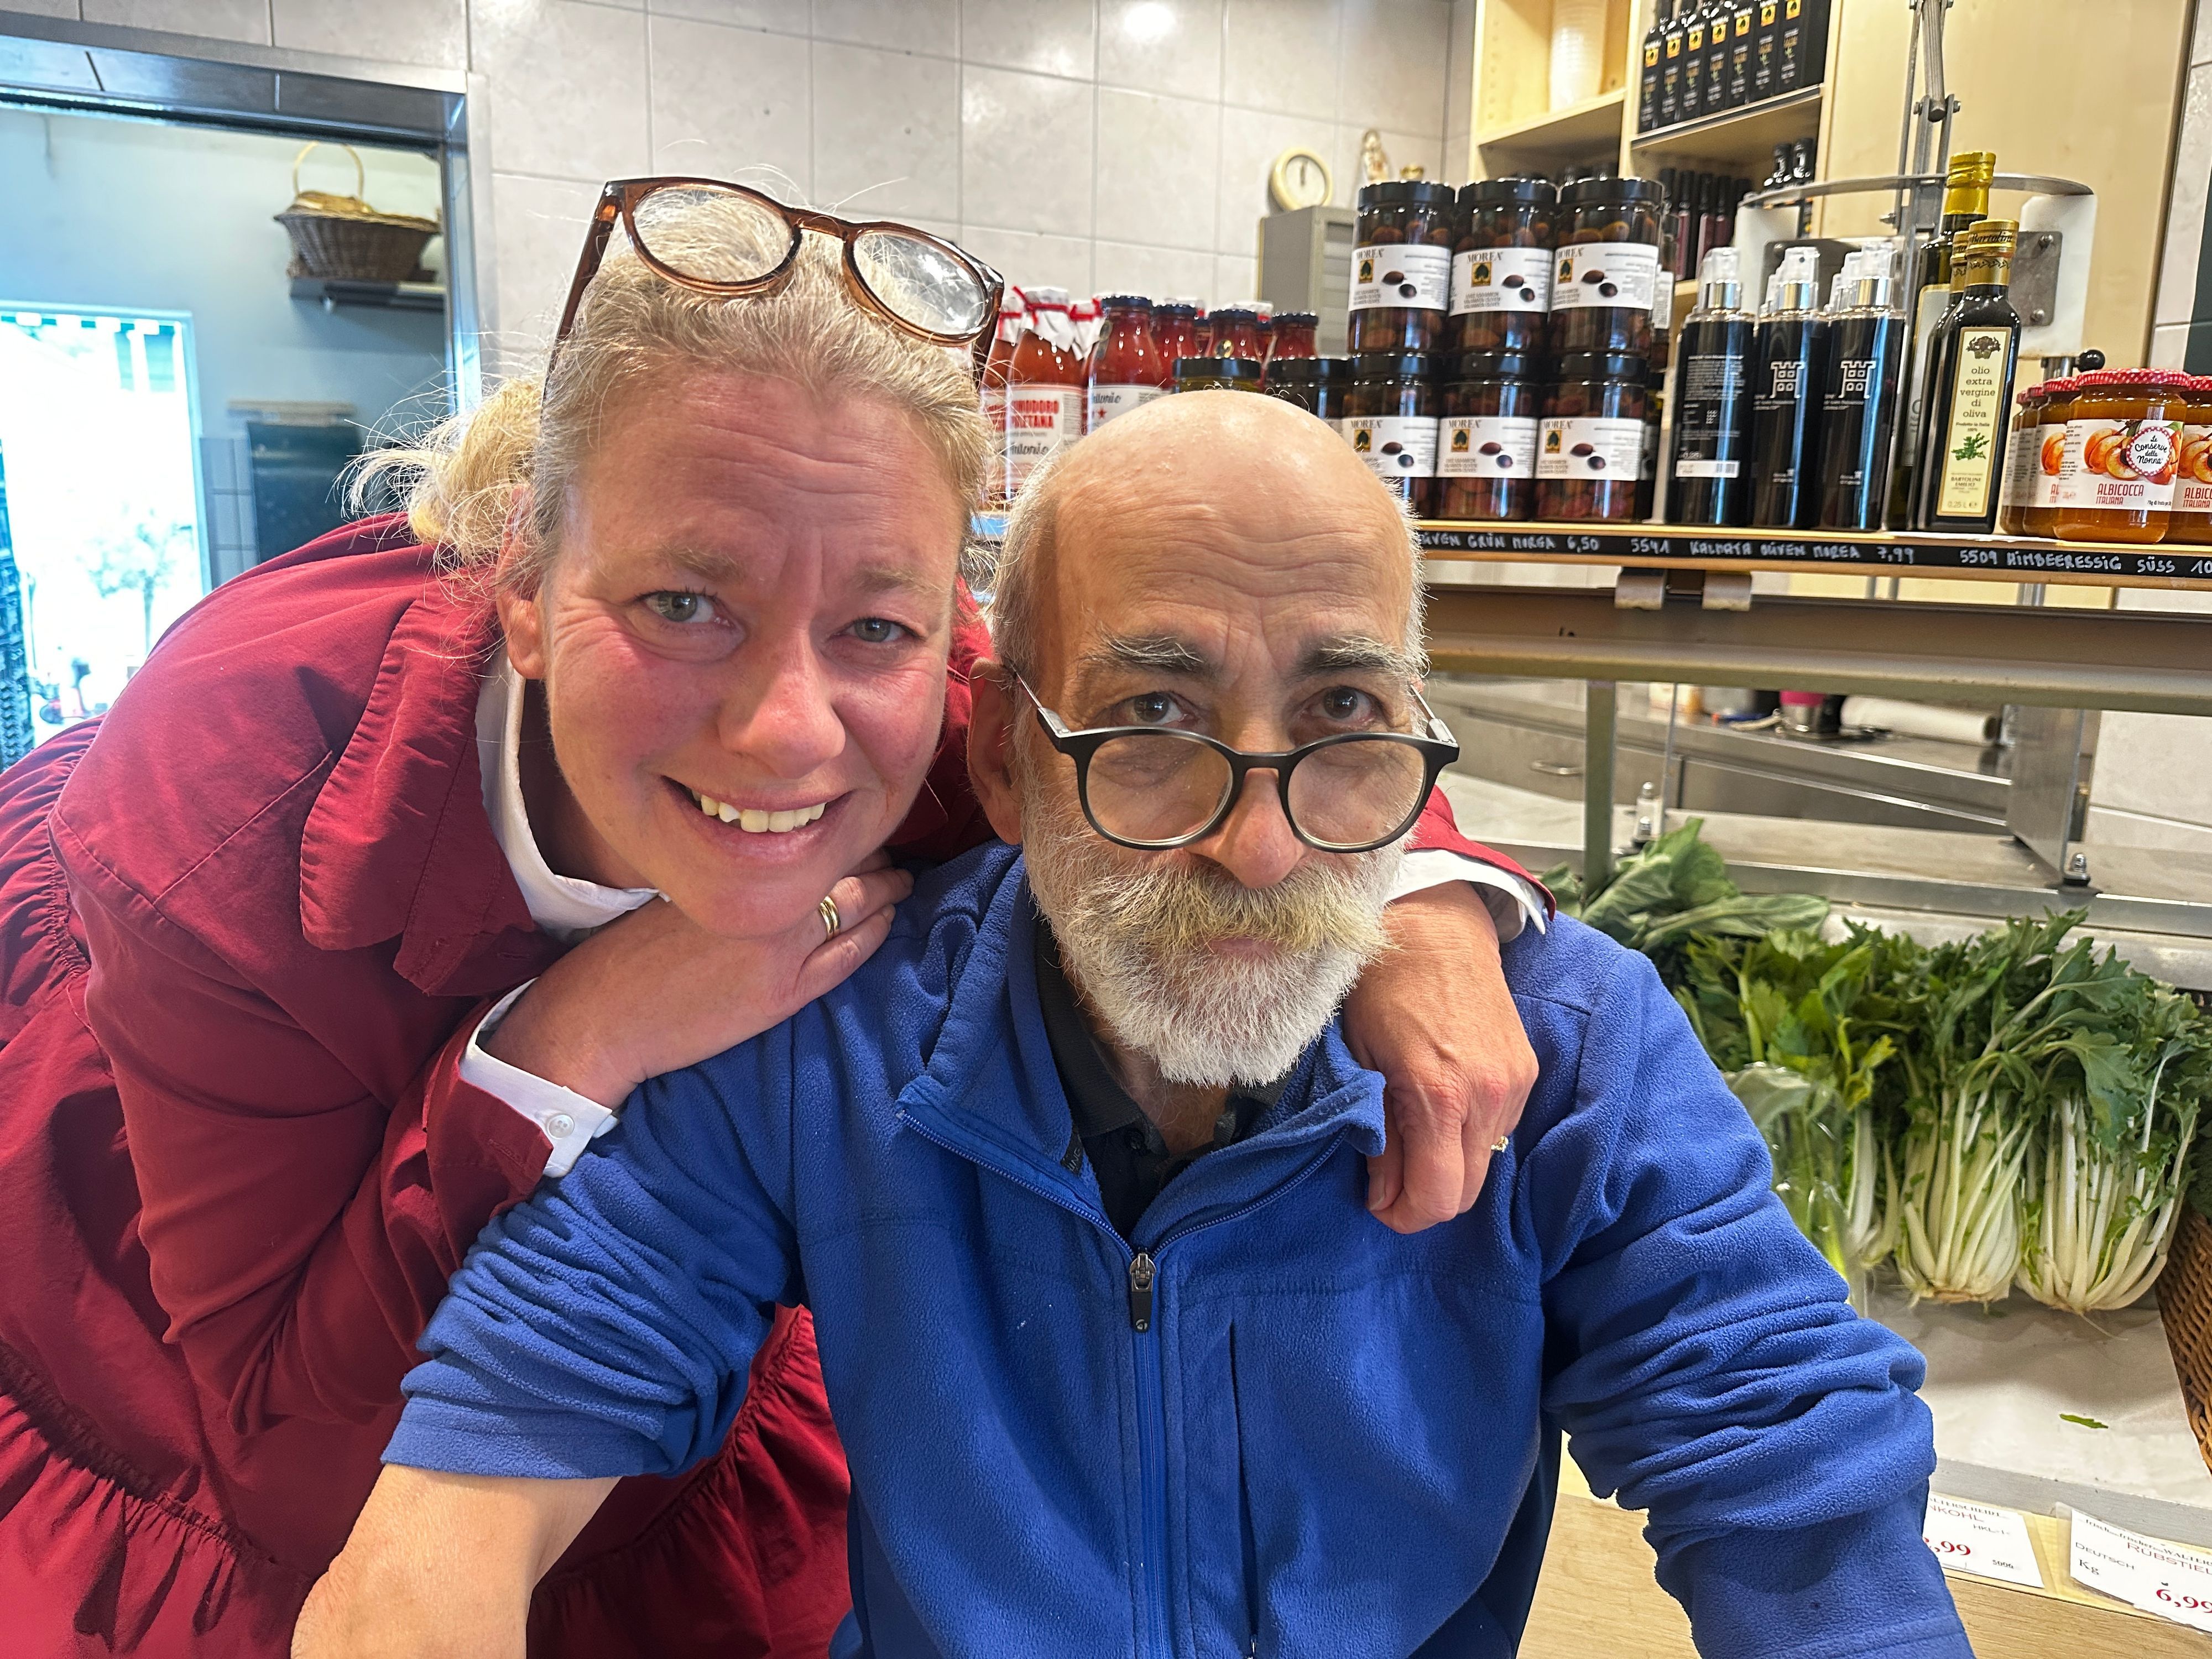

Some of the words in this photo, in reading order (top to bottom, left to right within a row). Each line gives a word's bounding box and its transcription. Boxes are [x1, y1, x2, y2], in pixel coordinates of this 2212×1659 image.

[1971, 366, 1990, 374] olio
[1960, 388, 1995, 398] vergine
[1963, 409, 1986, 418] oliva
[2135, 443, 2167, 453] Conserve
[2137, 455, 2162, 464] Nonna
[2097, 483, 2144, 496] ALBICOCCA
[2096, 497, 2124, 505] ITALIANA
[2183, 499, 2210, 508] ITALIANA
[1959, 549, 1998, 565] 5509
[2137, 556, 2176, 573] SÜSS
[2075, 1542, 2135, 1570] DEUTSCH
[2079, 1558, 2100, 1575] Kg
[2156, 1589, 2212, 1613] 6,99
